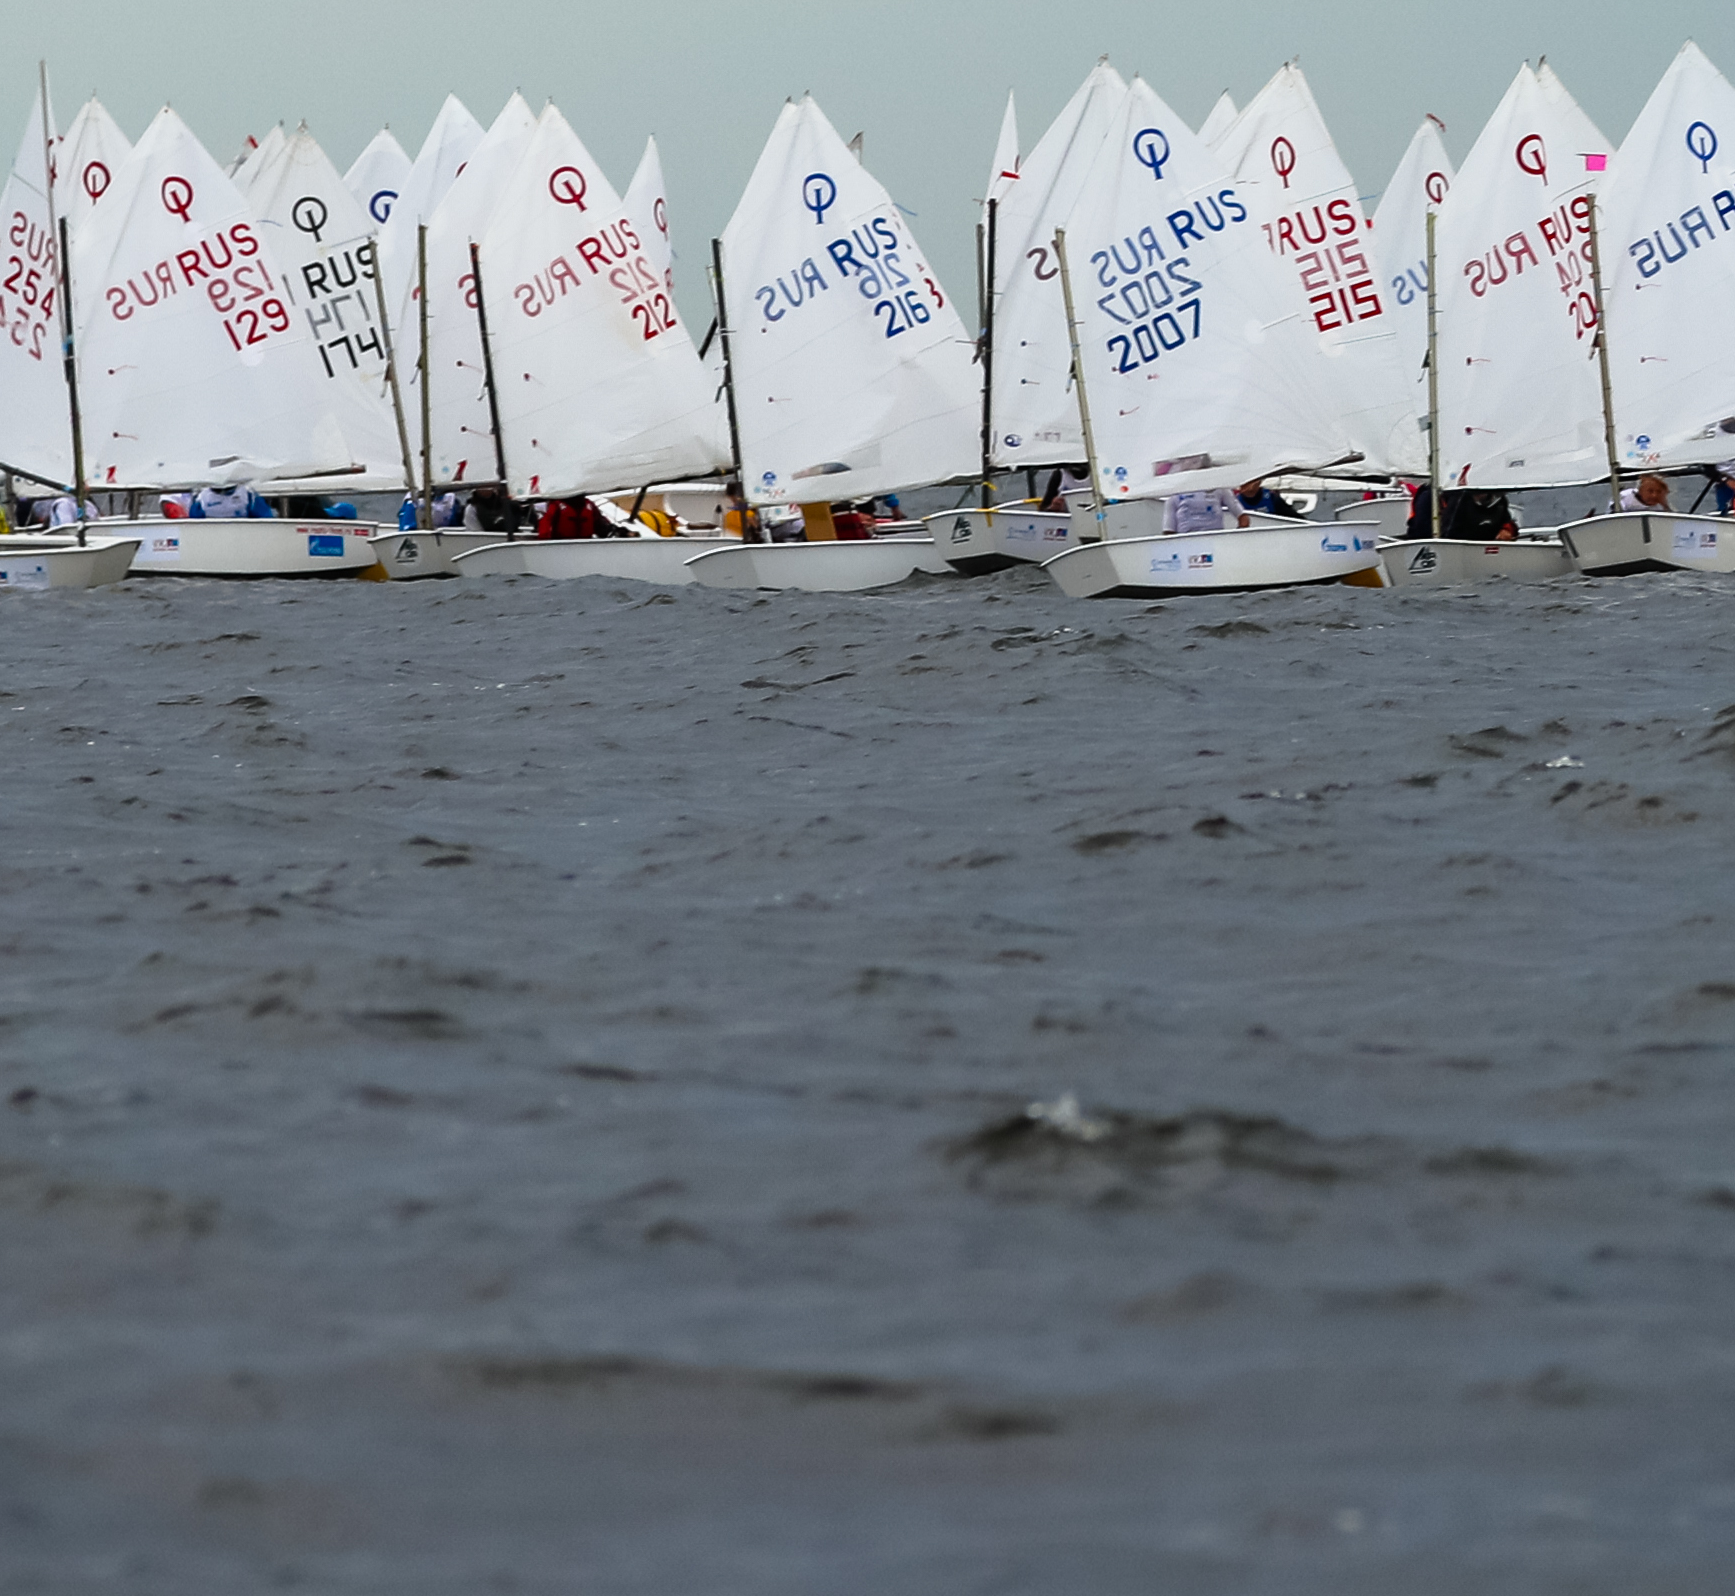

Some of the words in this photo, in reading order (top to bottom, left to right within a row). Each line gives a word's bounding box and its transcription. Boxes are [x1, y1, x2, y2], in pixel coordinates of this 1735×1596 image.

[575, 218, 641, 275] RUS
[1166, 188, 1249, 250] RUS
[1277, 199, 1357, 255] RUS
[1537, 196, 1591, 256] RUS
[176, 222, 260, 287] RUS
[301, 243, 375, 299] RUS
[826, 216, 899, 279] RUS
[3, 256, 55, 321] 254
[874, 289, 930, 340] 216
[1308, 278, 1383, 332] 215
[222, 297, 290, 352] 129
[631, 293, 677, 341] 212
[1106, 298, 1202, 374] 2007
[318, 326, 385, 379] 174
